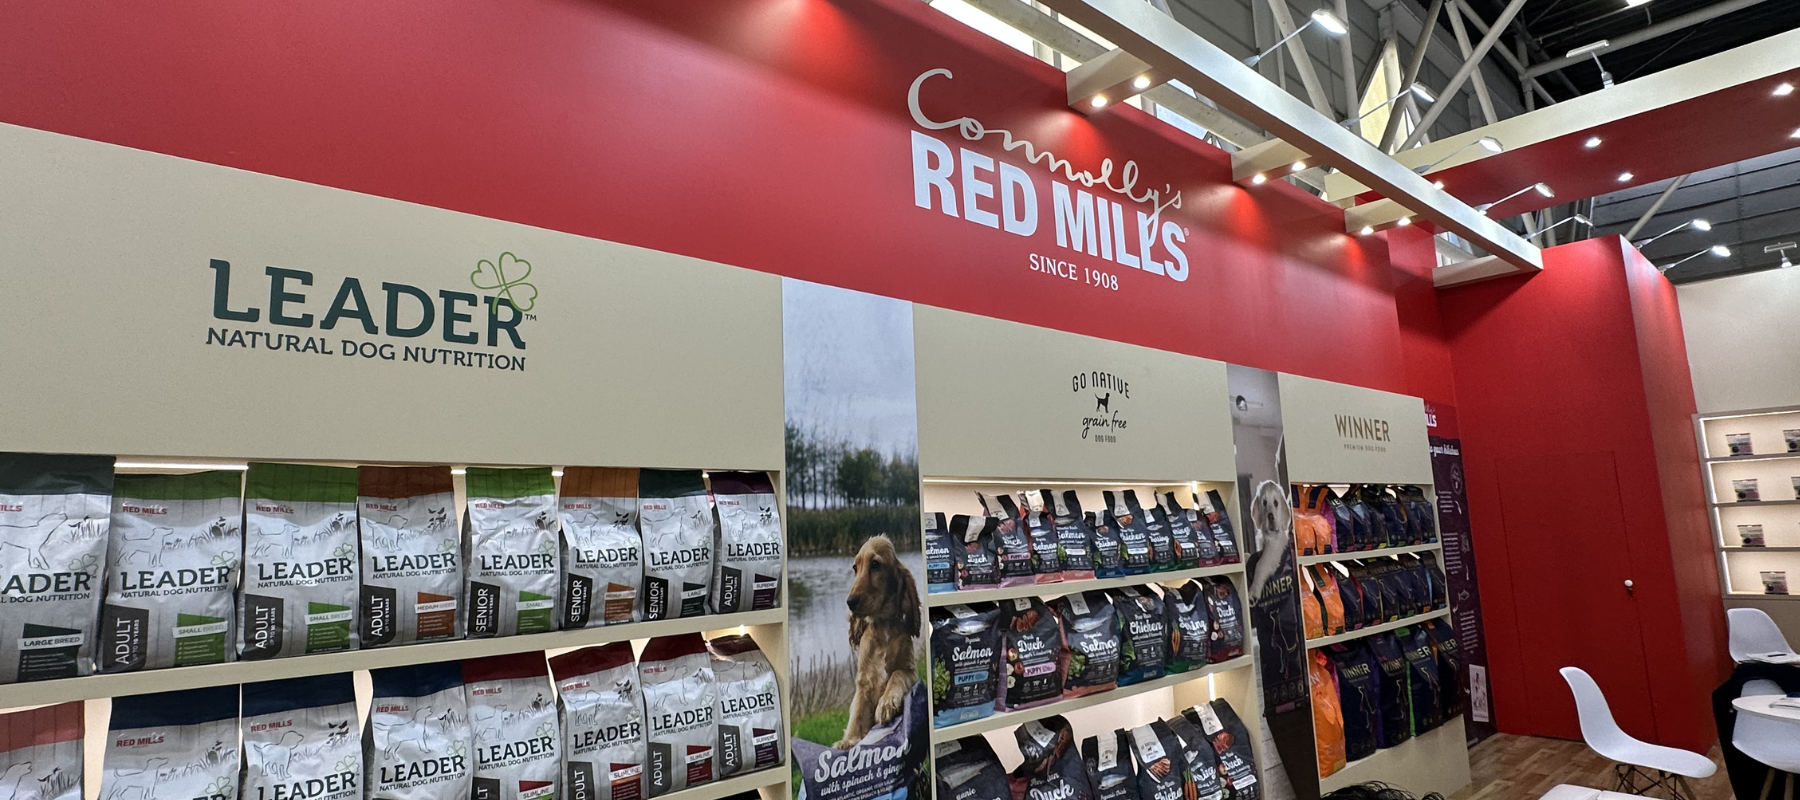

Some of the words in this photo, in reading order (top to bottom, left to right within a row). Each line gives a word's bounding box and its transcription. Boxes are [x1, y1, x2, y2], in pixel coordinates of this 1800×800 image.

[908, 68, 1182, 247] Connolly's
[911, 130, 1038, 236] RED
[1052, 180, 1188, 282] MILLS
[1029, 253, 1078, 281] SINCE
[1084, 267, 1119, 291] 1908
[210, 259, 526, 350] LEADER
[206, 327, 334, 356] NATURAL
[341, 340, 396, 361] DOG
[403, 346, 526, 372] NUTRITION
[1073, 373, 1087, 392] GO
[1092, 371, 1130, 399] NATIVE
[1082, 415, 1110, 440] grain
[1112, 410, 1127, 433] free
[1334, 414, 1391, 442] WINNER
[122, 505, 141, 514] RED
[142, 505, 167, 515] MILLS
[256, 506, 271, 514] RED
[366, 503, 379, 511] RED
[575, 547, 639, 564] LEADER
[651, 547, 710, 567] LEADER
[728, 542, 780, 557] LEADER
[258, 558, 352, 581] LEADER
[372, 552, 456, 574] LEADER
[481, 553, 554, 571] LEADER
[121, 567, 230, 590] LEADER
[257, 578, 295, 589] NATURAL
[296, 577, 313, 587] DOG
[315, 574, 354, 585] NUTRITION
[372, 569, 404, 580] NATURAL
[406, 568, 421, 577] DOG
[121, 589, 160, 599] NATURAL
[163, 587, 184, 597] DOG
[186, 583, 228, 595] NUTRITION
[725, 575, 734, 606] ADULT
[756, 581, 775, 589] SUPREME
[11, 593, 34, 603] DOG
[37, 591, 91, 602] NUTRITION
[571, 580, 583, 622] SENIOR
[649, 581, 660, 619] SENIOR
[371, 596, 384, 637] ADULT
[476, 588, 489, 632] SENIOR
[178, 627, 202, 636] SMALL
[255, 606, 268, 649] ADULT
[1130, 619, 1164, 635] Chicken
[24, 637, 53, 648] LARGE
[54, 636, 80, 645] BREED
[116, 617, 132, 665] ADULT
[1017, 636, 1045, 653] Duck
[952, 645, 994, 662] Salmon
[957, 675, 974, 683] PUPPY
[1026, 667, 1042, 675] PUPPY
[391, 704, 409, 712] MILLS
[721, 692, 775, 714] LEADER
[250, 724, 267, 733] RED
[268, 720, 293, 731] MILLS
[653, 706, 713, 731] LEADER
[116, 739, 135, 748] RED
[137, 736, 165, 746] MILLS
[574, 722, 641, 749] LEADER
[478, 736, 555, 765] LEADER
[574, 746, 598, 755] NATURAL
[724, 732, 735, 766] ADULT
[380, 755, 466, 784] LEADER
[479, 762, 508, 771] NATURAL
[509, 759, 522, 767] DOG
[523, 752, 555, 764] NUTRITION
[653, 751, 663, 786] ADULT
[814, 738, 911, 783] Salmon
[380, 782, 411, 792] NATURAL
[412, 779, 428, 788] DOG
[430, 771, 466, 784] NUTRITION
[613, 766, 641, 779] SLIMLINE
[821, 781, 841, 797] with
[842, 769, 875, 792] spinach
[876, 768, 883, 778] &
[258, 771, 357, 800] LEADER
[523, 788, 552, 799] SLIMLINE
[1029, 779, 1074, 800] Duck
